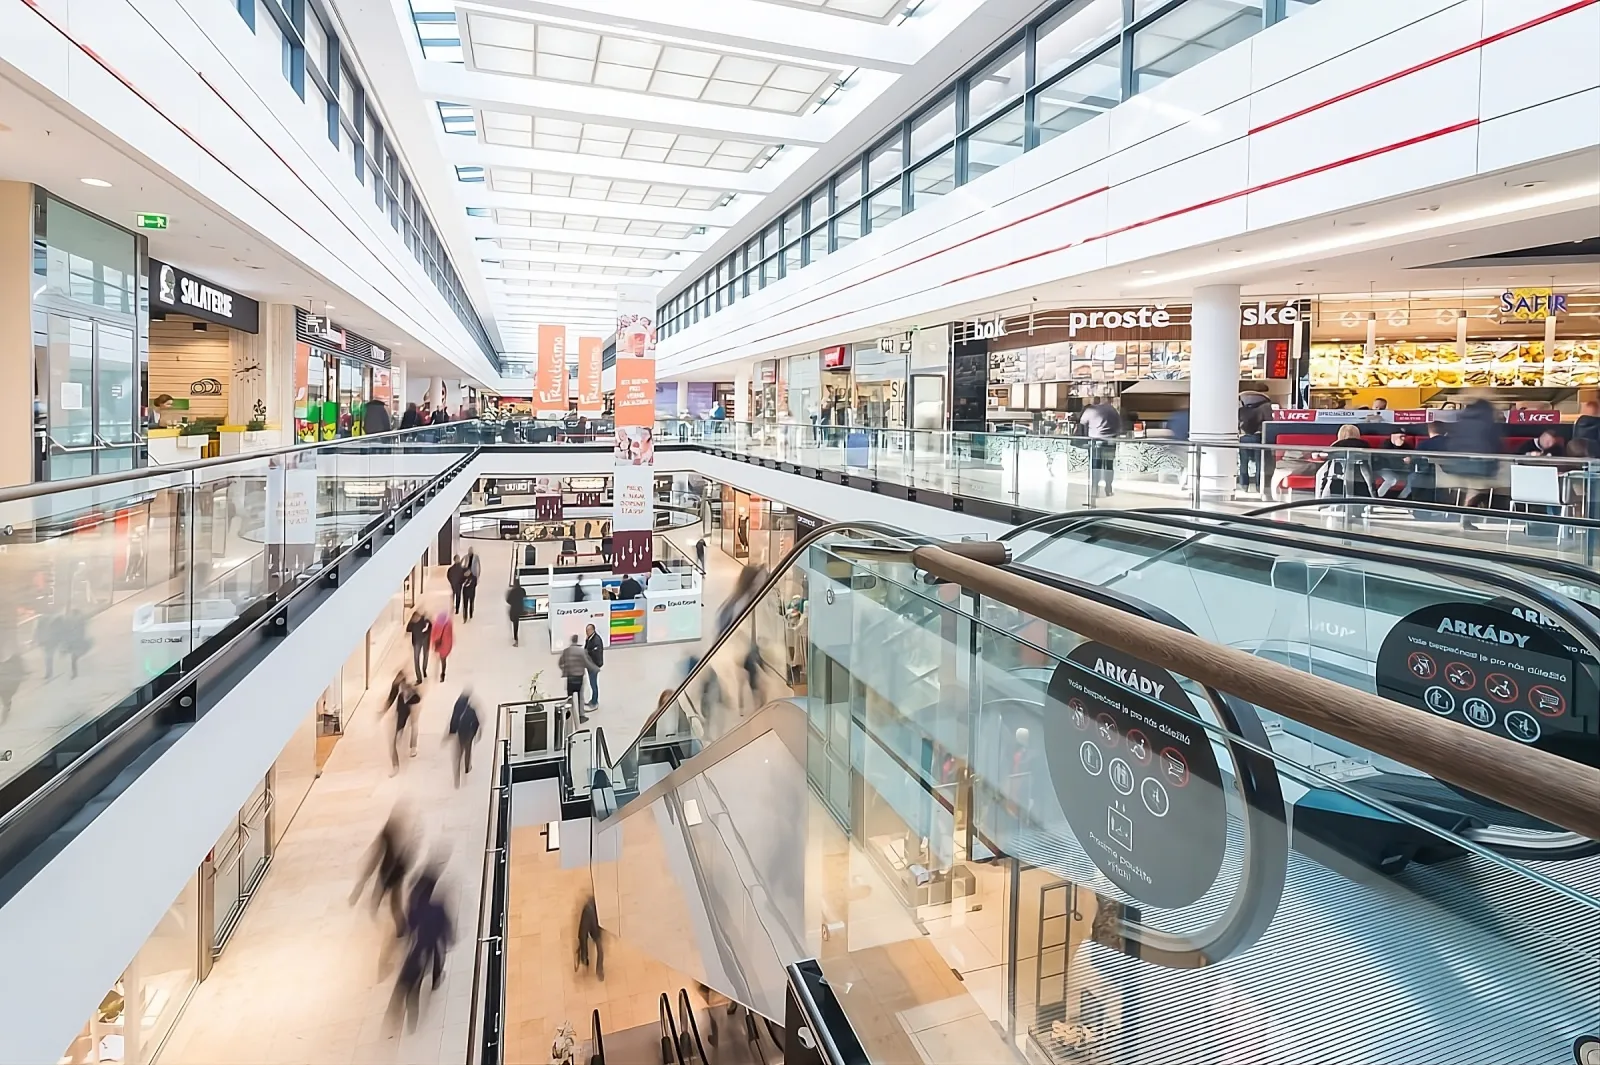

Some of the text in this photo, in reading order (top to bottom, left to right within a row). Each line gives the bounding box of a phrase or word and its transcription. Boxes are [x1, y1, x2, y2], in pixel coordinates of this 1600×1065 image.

[181, 277, 233, 318] SALATERIE
[1500, 292, 1567, 313] SAFIR
[1069, 303, 1170, 337] prostě
[1287, 411, 1310, 421] KFC
[1528, 413, 1555, 422] KFC
[1437, 617, 1530, 649] ARKÁDY
[1490, 658, 1507, 667] pro
[1093, 657, 1165, 700] ARKÁDY
